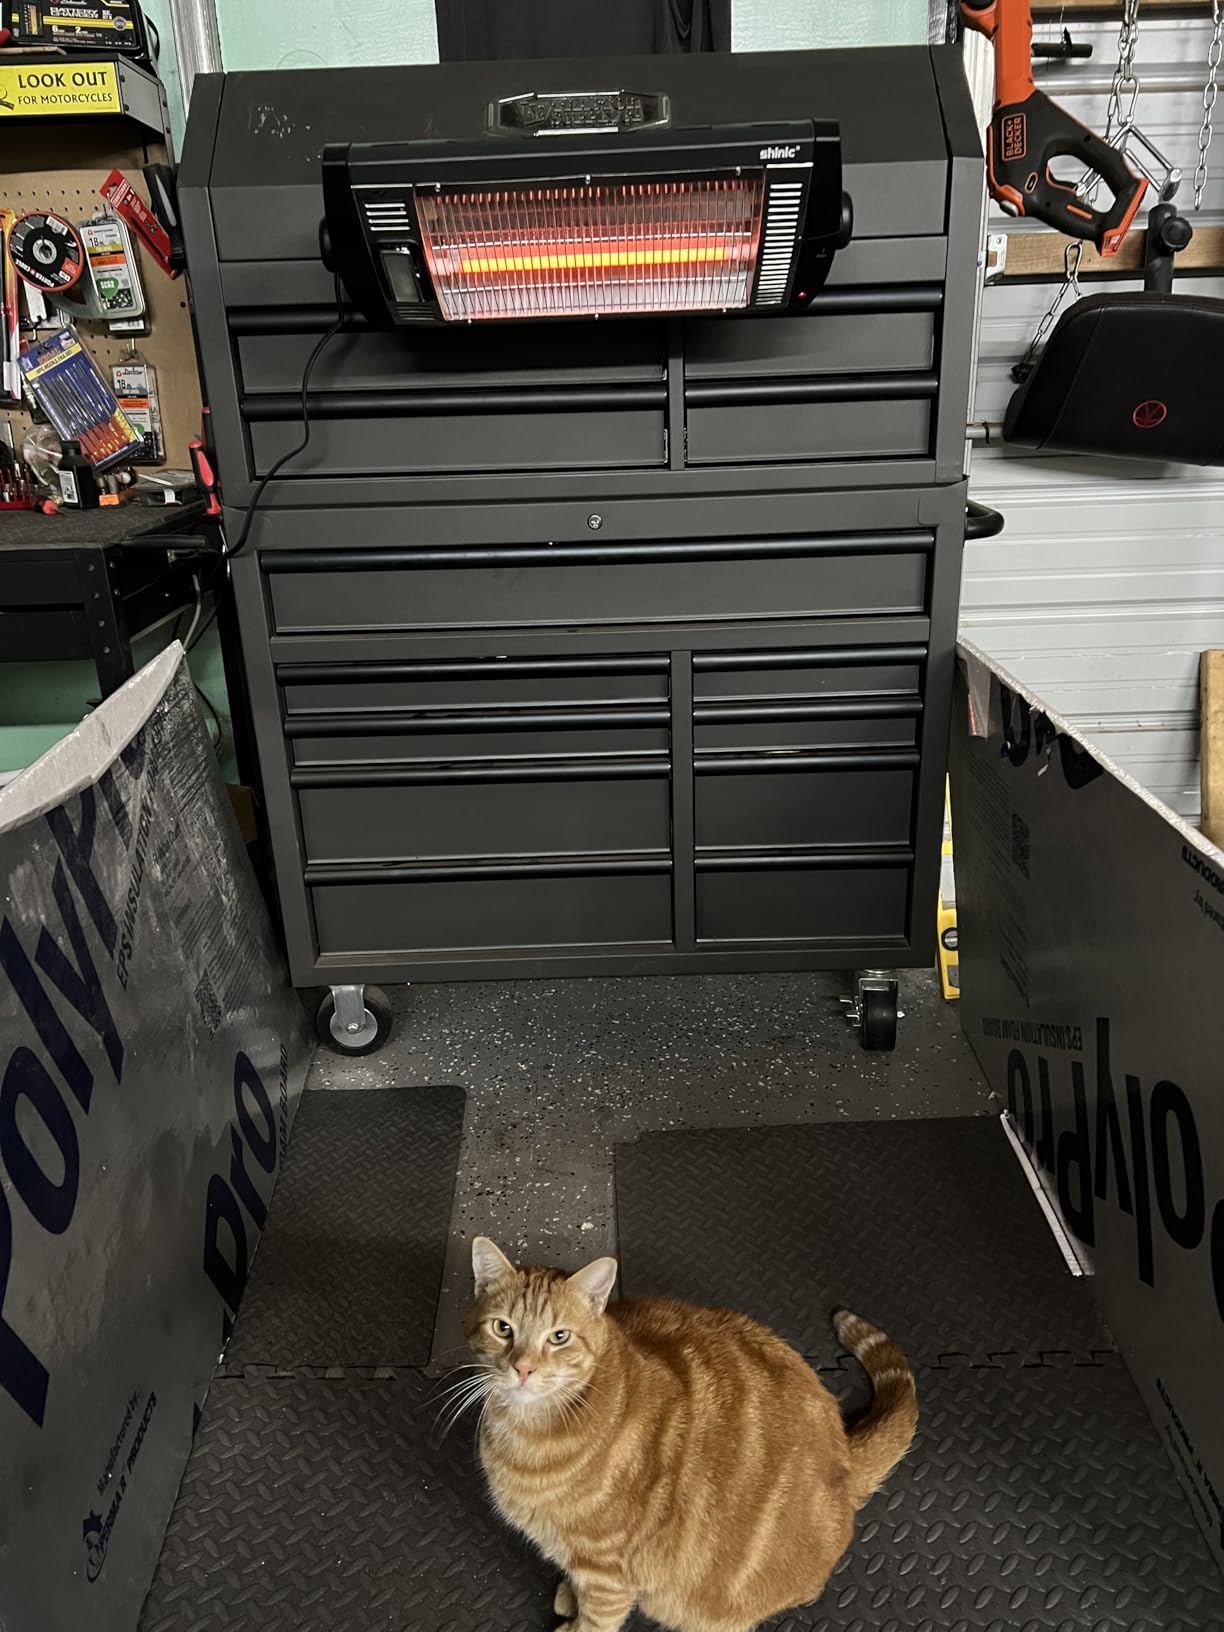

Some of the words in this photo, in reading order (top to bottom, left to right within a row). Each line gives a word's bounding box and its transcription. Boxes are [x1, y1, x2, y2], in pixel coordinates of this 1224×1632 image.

[18, 73, 67, 89] LOOK
[72, 72, 108, 87] OUT
[18, 95, 38, 105] FOR
[41, 93, 113, 104] MOTORCYCLES
[1014, 117, 1022, 155] DECKER
[89, 237, 99, 247] 18
[117, 379, 126, 389] 18
[122, 801, 153, 935] INSULATION
[117, 938, 132, 992] EPS
[1065, 1025, 1083, 1051] EPS
[279, 1043, 289, 1110] BOARD
